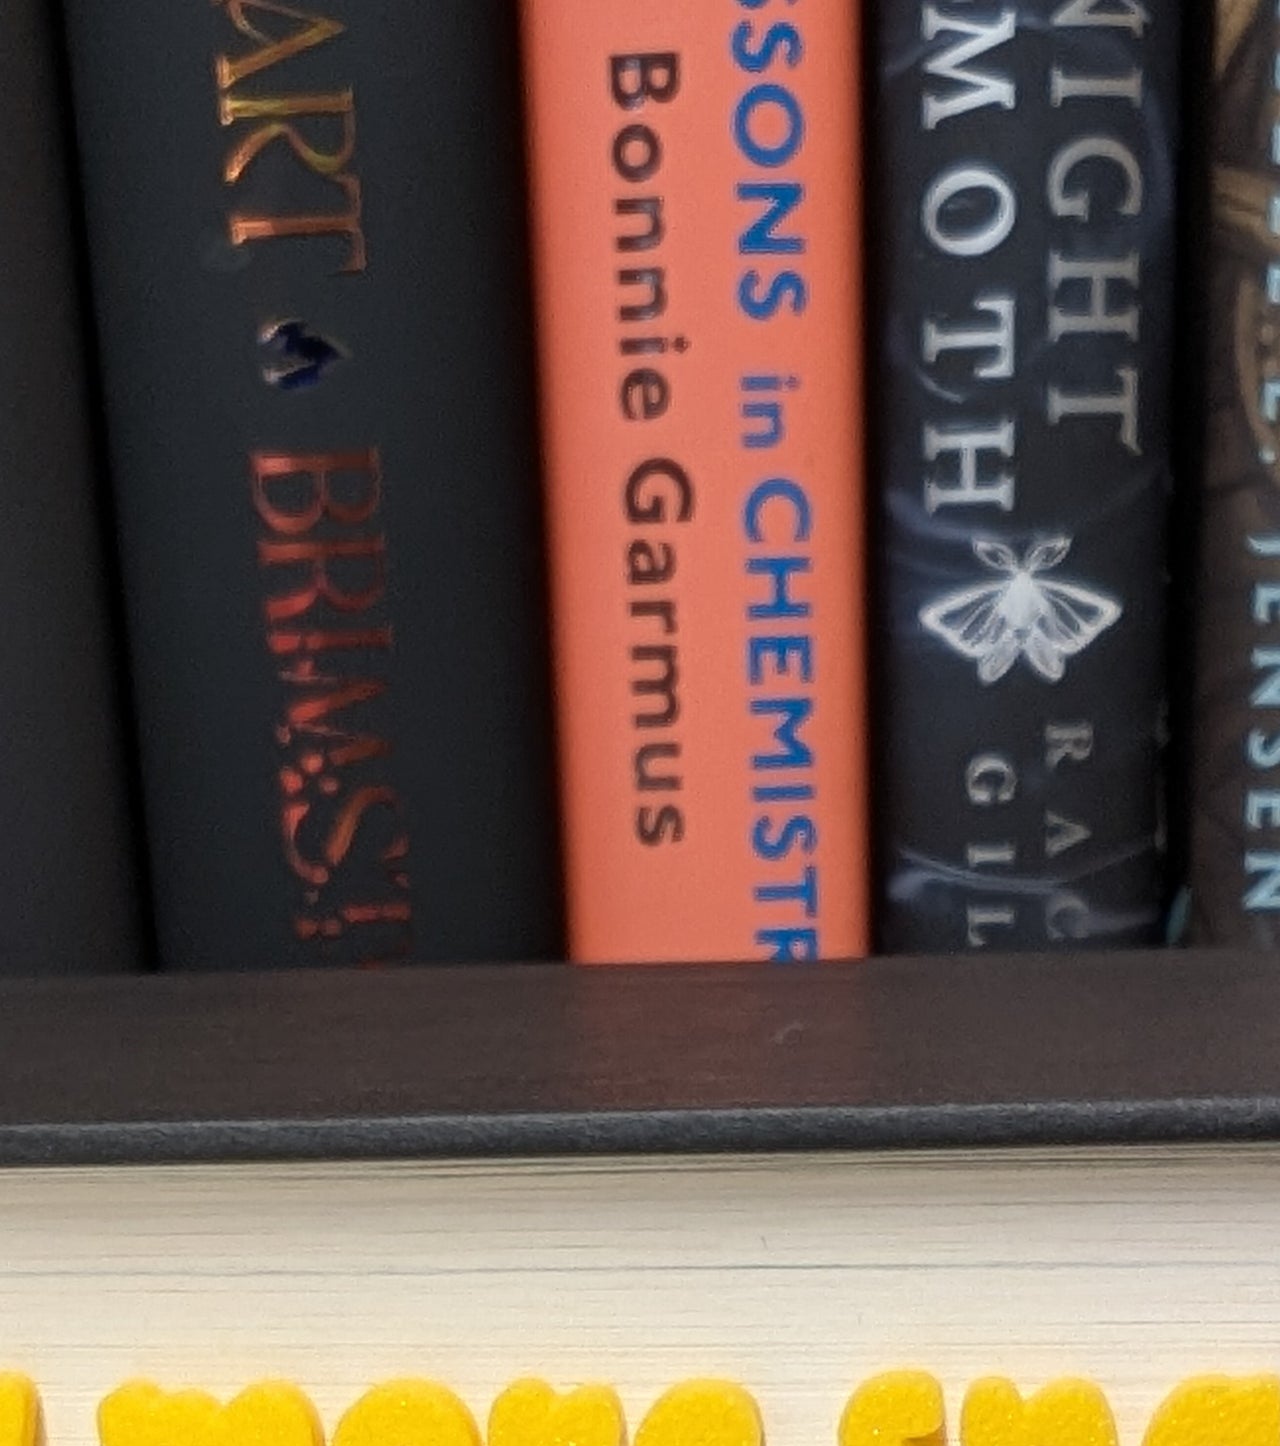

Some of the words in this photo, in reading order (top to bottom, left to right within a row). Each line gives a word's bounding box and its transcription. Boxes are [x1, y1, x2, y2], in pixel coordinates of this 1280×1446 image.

[607, 51, 692, 424] Bonnie
[729, 0, 809, 321] SONS
[921, 4, 1017, 515] MOTH
[738, 373, 801, 451] in
[622, 456, 698, 848] Garmus
